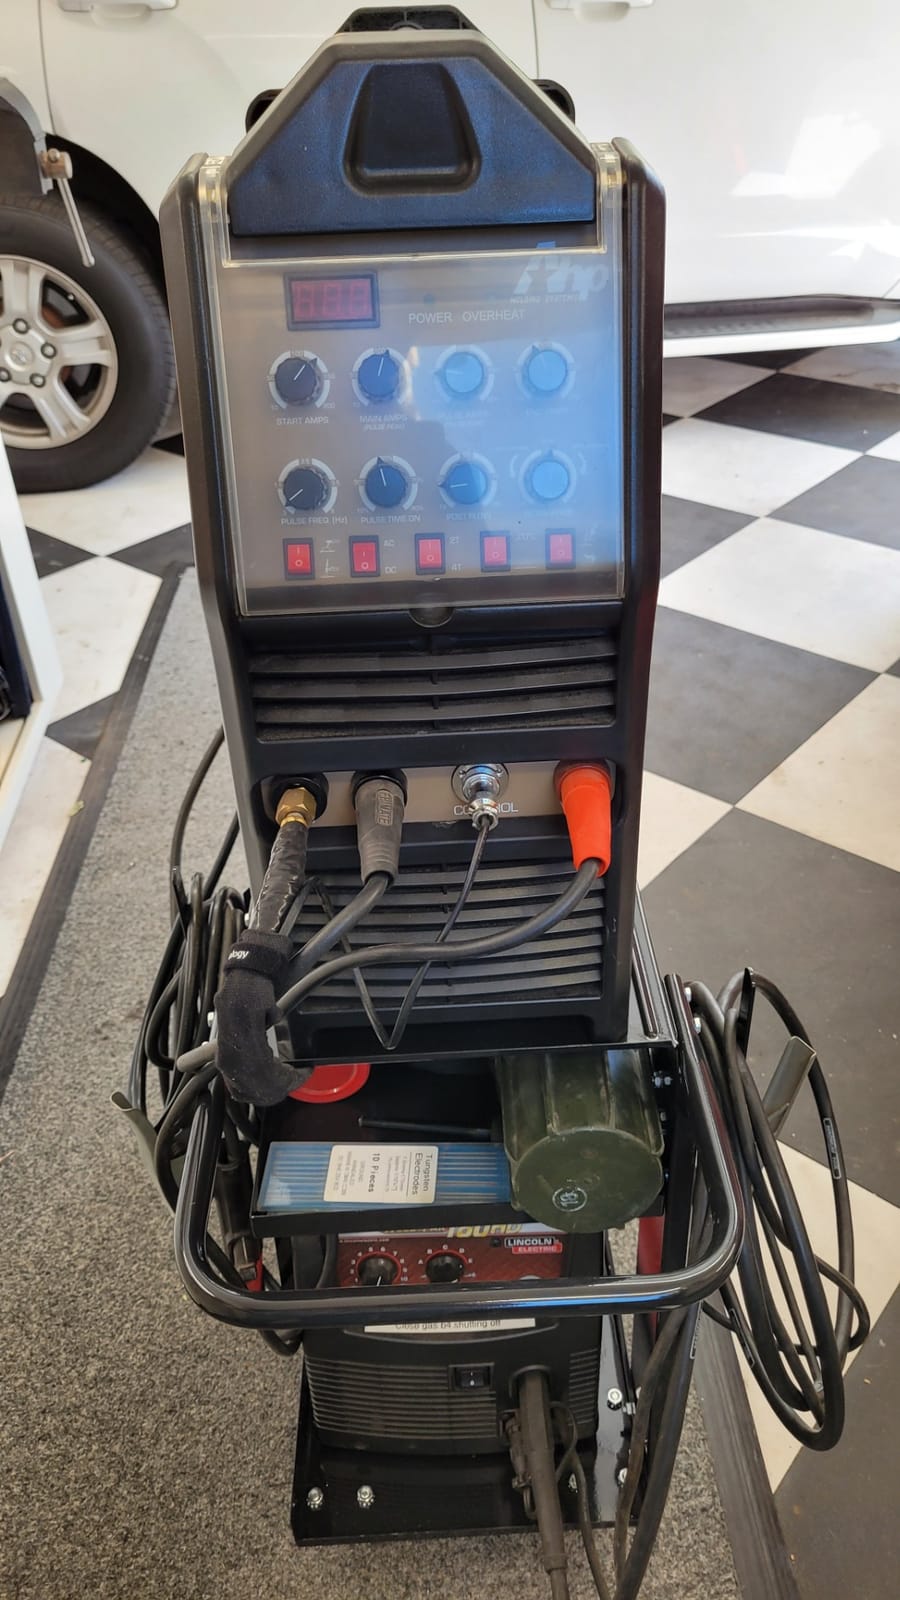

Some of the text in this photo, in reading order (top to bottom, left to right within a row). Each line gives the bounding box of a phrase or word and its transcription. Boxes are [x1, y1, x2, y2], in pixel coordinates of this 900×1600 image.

[408, 312, 453, 325] POWER
[461, 309, 526, 323] OVERHEAT
[276, 415, 329, 426] START AMPS
[281, 517, 306, 526] PULSE
[360, 516, 386, 526] PULSE
[368, 1152, 381, 1193] 10 Pieces
[411, 1151, 424, 1196] Electrodes
[422, 1153, 433, 1192] Tungsten
[507, 1238, 553, 1247] LINCOLN
[518, 1245, 558, 1253] ELECTRIC
[421, 1322, 439, 1331] gas
[453, 1319, 488, 1330] shutting
